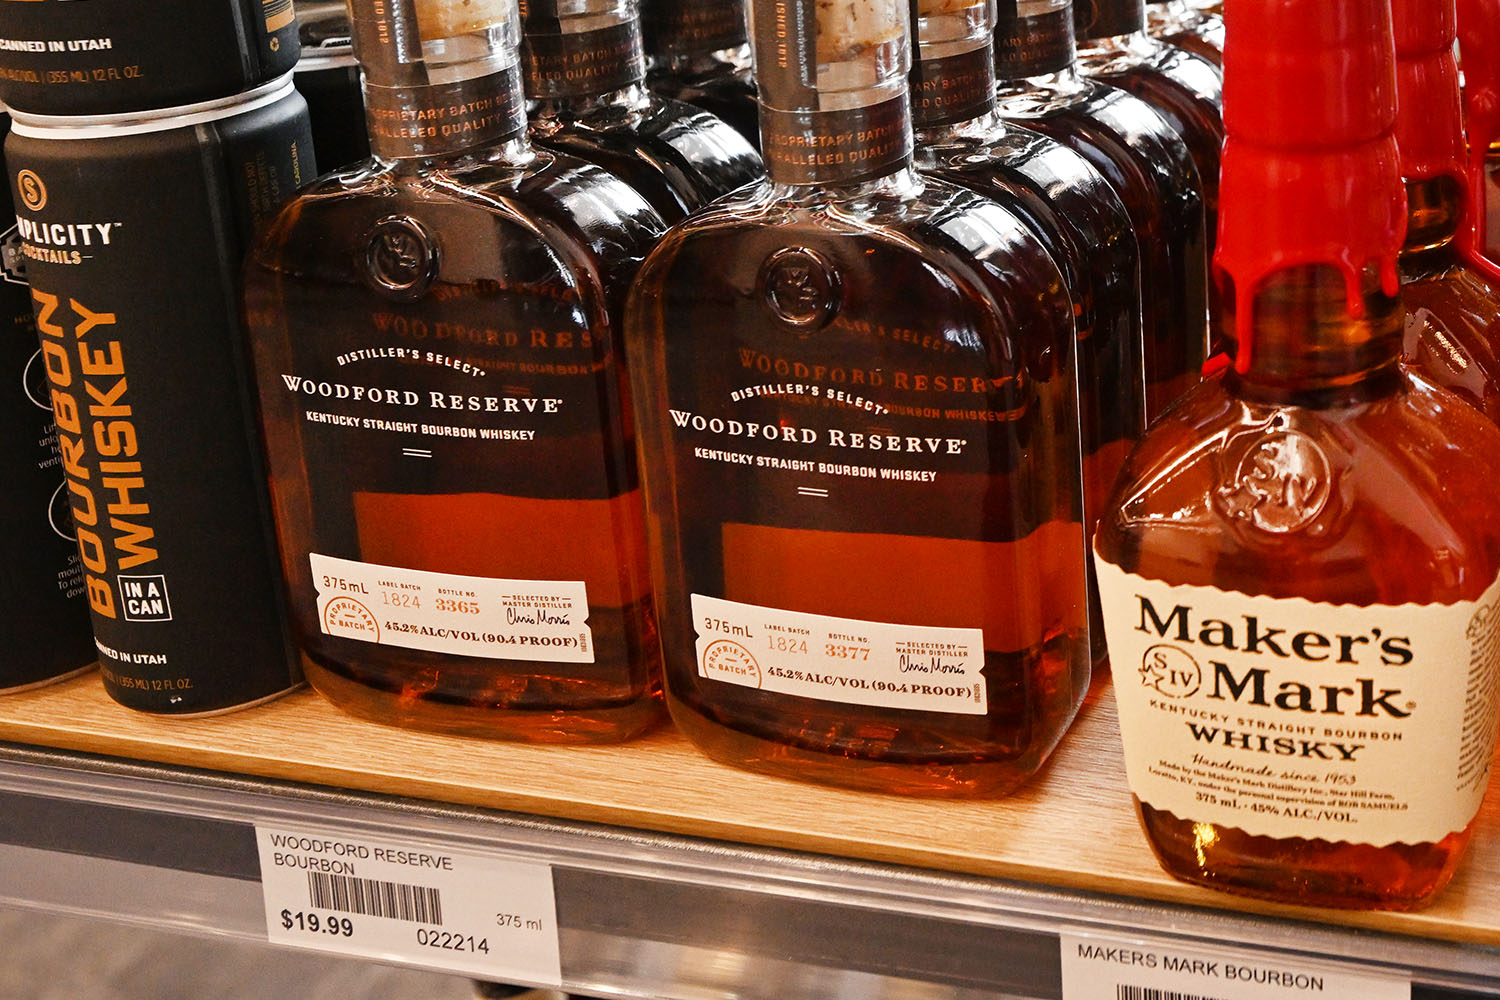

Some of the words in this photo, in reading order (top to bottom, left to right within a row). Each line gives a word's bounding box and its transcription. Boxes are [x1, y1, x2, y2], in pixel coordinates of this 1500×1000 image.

[48, 41, 66, 53] IN
[68, 38, 113, 52] UTAH
[336, 347, 420, 367] DISTILLER'S
[282, 374, 420, 407] WOODFORD
[430, 391, 559, 414] RESERVE
[730, 382, 819, 403] DISTILLER'S
[69, 297, 159, 572] WHISKEY
[305, 410, 361, 428] KENTUCKY
[362, 417, 418, 434] STRAIGHT
[421, 423, 477, 440] BOURBON
[480, 429, 535, 442] WHISKEY
[668, 408, 818, 444] WOODFORD
[828, 428, 962, 455] RESERVE
[32, 287, 117, 620] BOURBON
[694, 446, 754, 466] KENTUCKY
[756, 455, 815, 473] STRAIGHT
[818, 462, 877, 480] BOURBON
[880, 468, 937, 483] WHISKEY
[124, 582, 143, 598] IN
[147, 582, 160, 598] A
[323, 575, 369, 595] 375mL
[378, 580, 398, 589] LABEL
[400, 583, 421, 591] BATCH
[438, 588, 463, 598] BOTTLE
[127, 599, 165, 615] CAN
[381, 591, 421, 609] 1824
[435, 598, 481, 615] 3365
[512, 594, 549, 602] SELECTED
[329, 601, 376, 633] PROPRIETARY
[338, 619, 366, 631] BATCH
[384, 620, 419, 635] 45.2%
[420, 625, 480, 642] ALC/VOL
[482, 632, 517, 646] (90.4
[519, 635, 578, 649] PROOF)
[704, 617, 754, 639] 375mL
[764, 623, 785, 632] LABEL
[788, 627, 811, 636] BATCH
[828, 632, 855, 642] BOTTLE
[1133, 593, 1415, 667] Maker's
[767, 634, 808, 655] 1824
[824, 643, 871, 662] 3377
[895, 647, 926, 656] MASTER
[928, 649, 969, 657] DISTILLER
[906, 641, 945, 650] SELECTED
[119, 651, 132, 663] IN
[133, 653, 168, 665] UTAH
[708, 645, 757, 678] PROPRIETARY
[718, 663, 747, 676] BATCH
[164, 679, 175, 690] FL
[767, 666, 804, 681] 45.2%
[805, 672, 870, 690] ALC/VOL
[872, 679, 909, 693] (90.4
[910, 684, 972, 699] PROOF)
[1207, 659, 1413, 719] Mark
[1149, 699, 1229, 724] KENTUCKY
[1237, 717, 1316, 737] STRAIGHT
[1323, 728, 1403, 742] BOURBON
[1185, 721, 1365, 762] WHISKY
[1191, 752, 1273, 777] Handmade
[1280, 769, 1319, 782] since
[1324, 772, 1357, 786] 1953
[1195, 791, 1217, 805] 375
[1250, 802, 1280, 816] 45%
[269, 832, 370, 860] WOODFORD
[374, 847, 454, 872] RESERVE
[273, 851, 356, 876] BOURBON
[280, 908, 354, 938] $19.99
[495, 912, 523, 929] 375
[525, 918, 544, 932] ml
[416, 927, 490, 955] 022214
[1077, 942, 1158, 969] MAKERS
[1162, 955, 1220, 979] MARK
[1224, 962, 1325, 993] BOURBON
